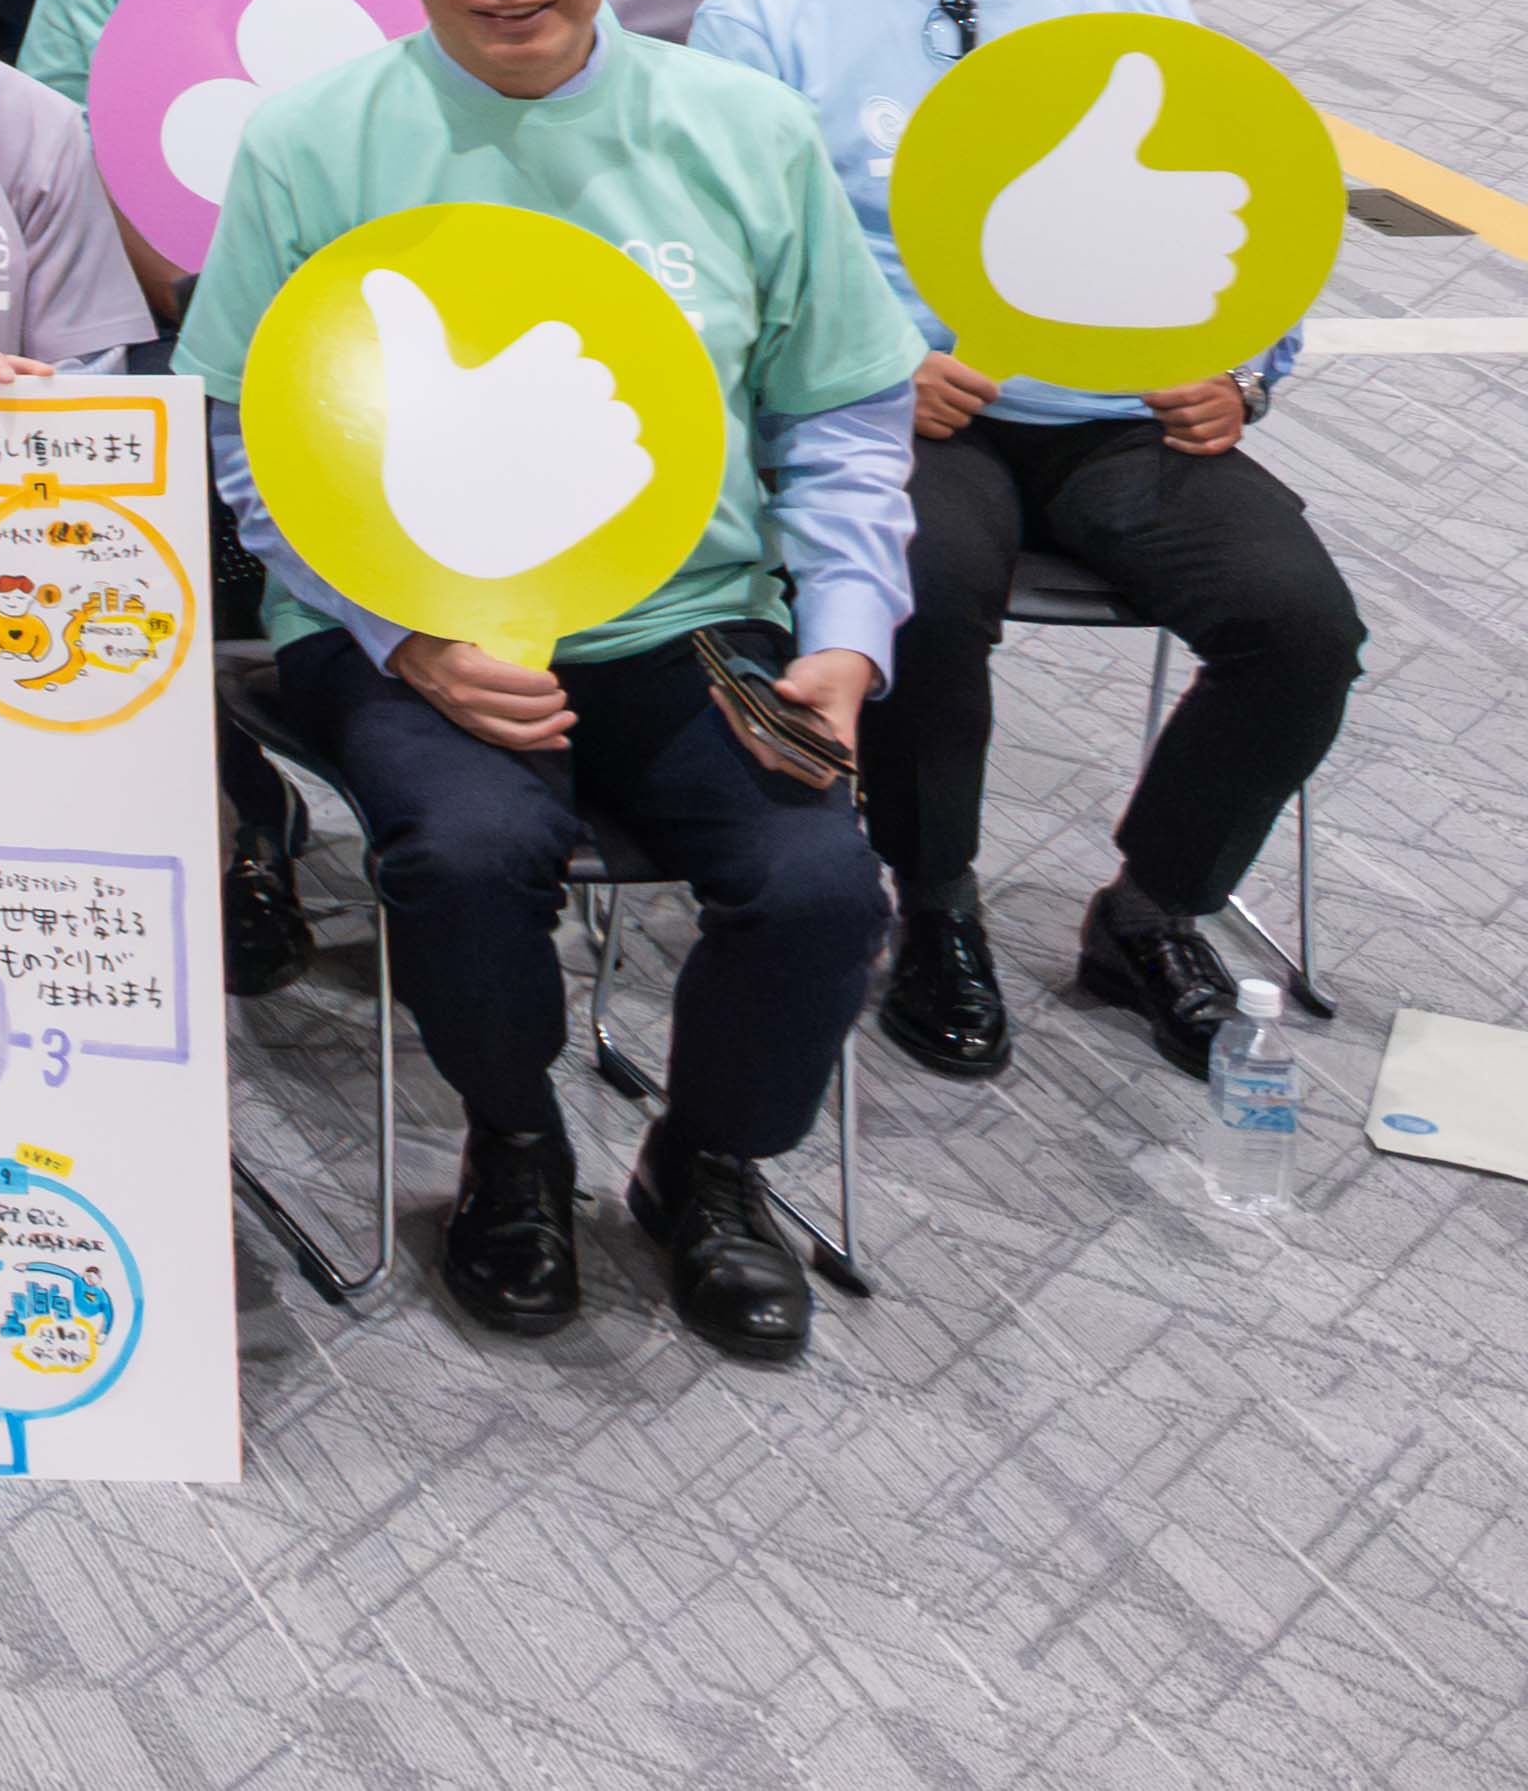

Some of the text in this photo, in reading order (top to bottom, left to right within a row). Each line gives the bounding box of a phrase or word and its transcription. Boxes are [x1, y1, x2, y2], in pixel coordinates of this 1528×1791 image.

[32, 481, 48, 501] 7
[37, 977, 163, 1010] 生まれるまち
[41, 1026, 73, 1088] 3
